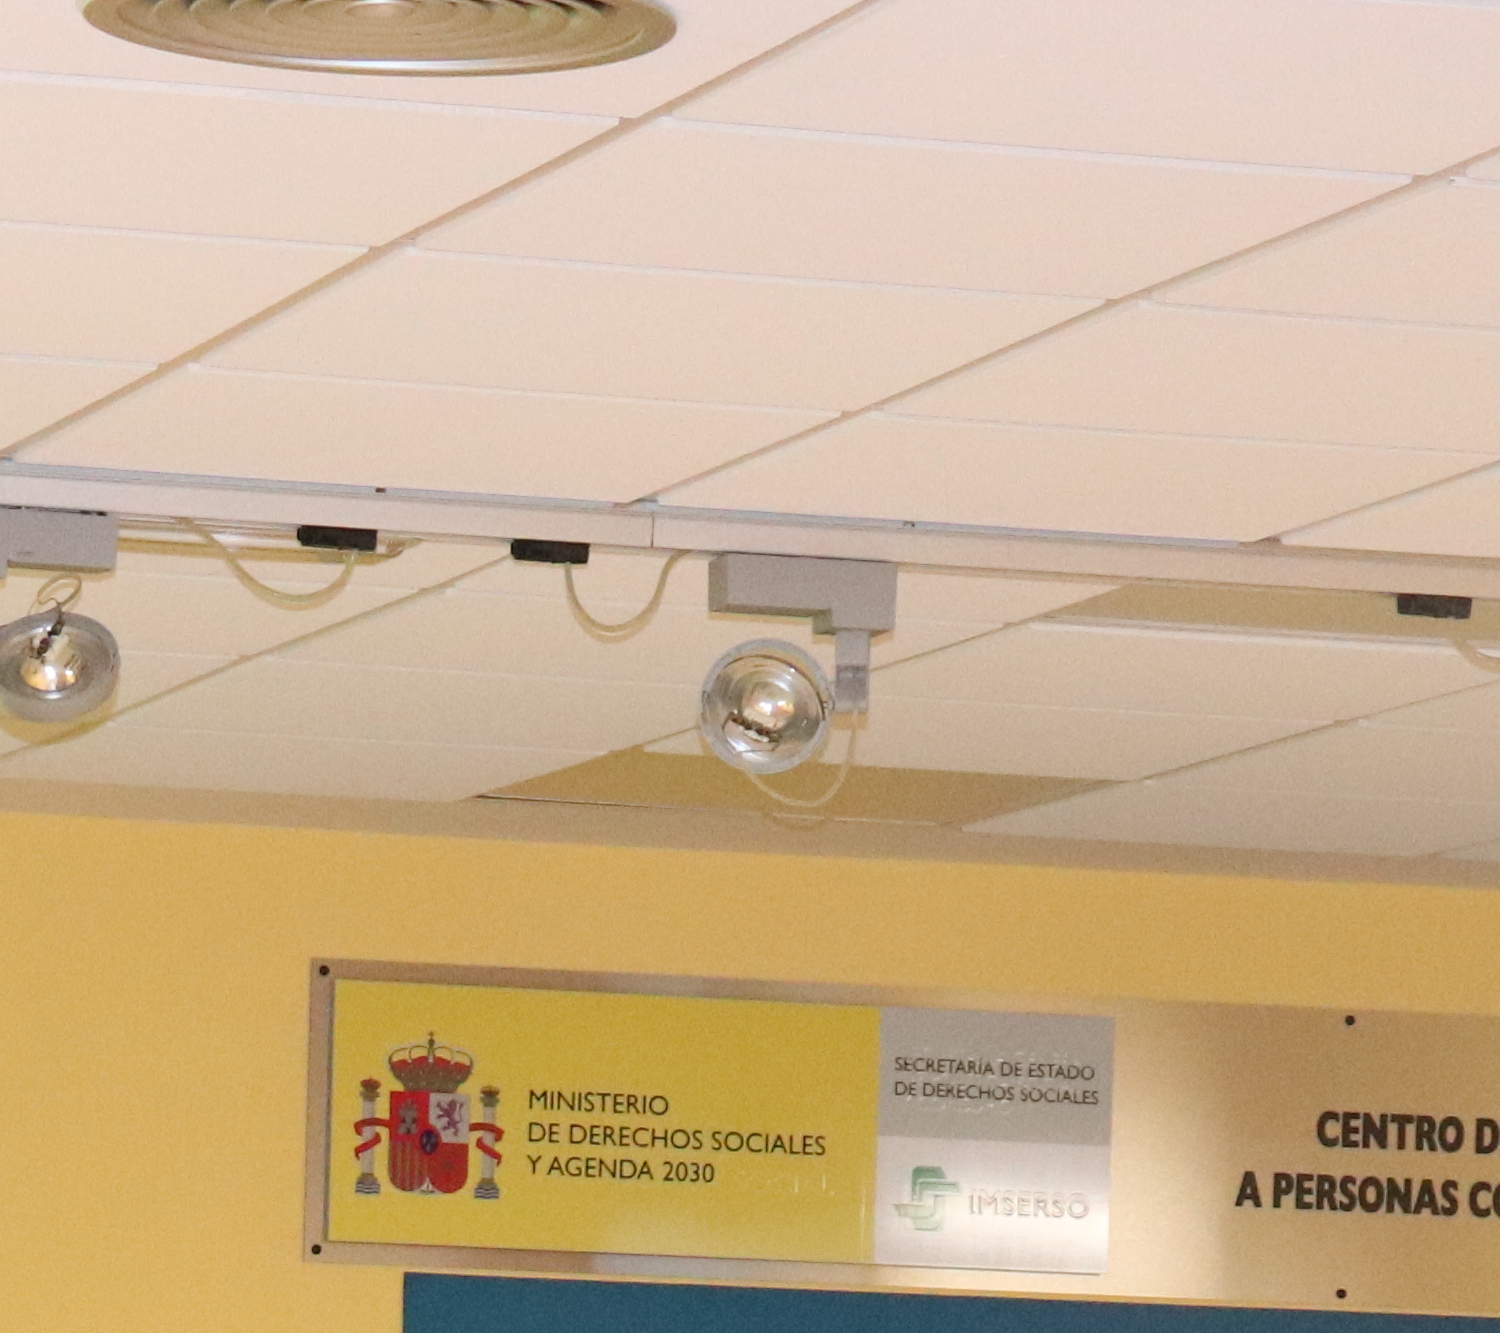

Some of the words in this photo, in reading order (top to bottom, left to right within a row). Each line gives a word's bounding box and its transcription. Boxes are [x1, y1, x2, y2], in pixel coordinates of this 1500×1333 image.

[1001, 1061, 1022, 1078] DE
[1029, 1061, 1095, 1080] ESTADO
[528, 1089, 669, 1116] MINISTERIO
[894, 1081, 915, 1097] DE
[922, 1083, 1013, 1102] DERECHOS
[1021, 1086, 1099, 1106] SOCIALES
[528, 1121, 561, 1144] DE
[568, 1123, 704, 1151] DERECHOS
[712, 1131, 825, 1156] SOCIALES
[1317, 1109, 1464, 1154] CENTRO
[528, 1154, 544, 1176] Y
[546, 1156, 653, 1182] AGENDA
[662, 1160, 714, 1184] 2030
[969, 1187, 1089, 1219] IMSERSO
[1235, 1170, 1262, 1206] A
[1273, 1171, 1458, 1216] PERSONAS
